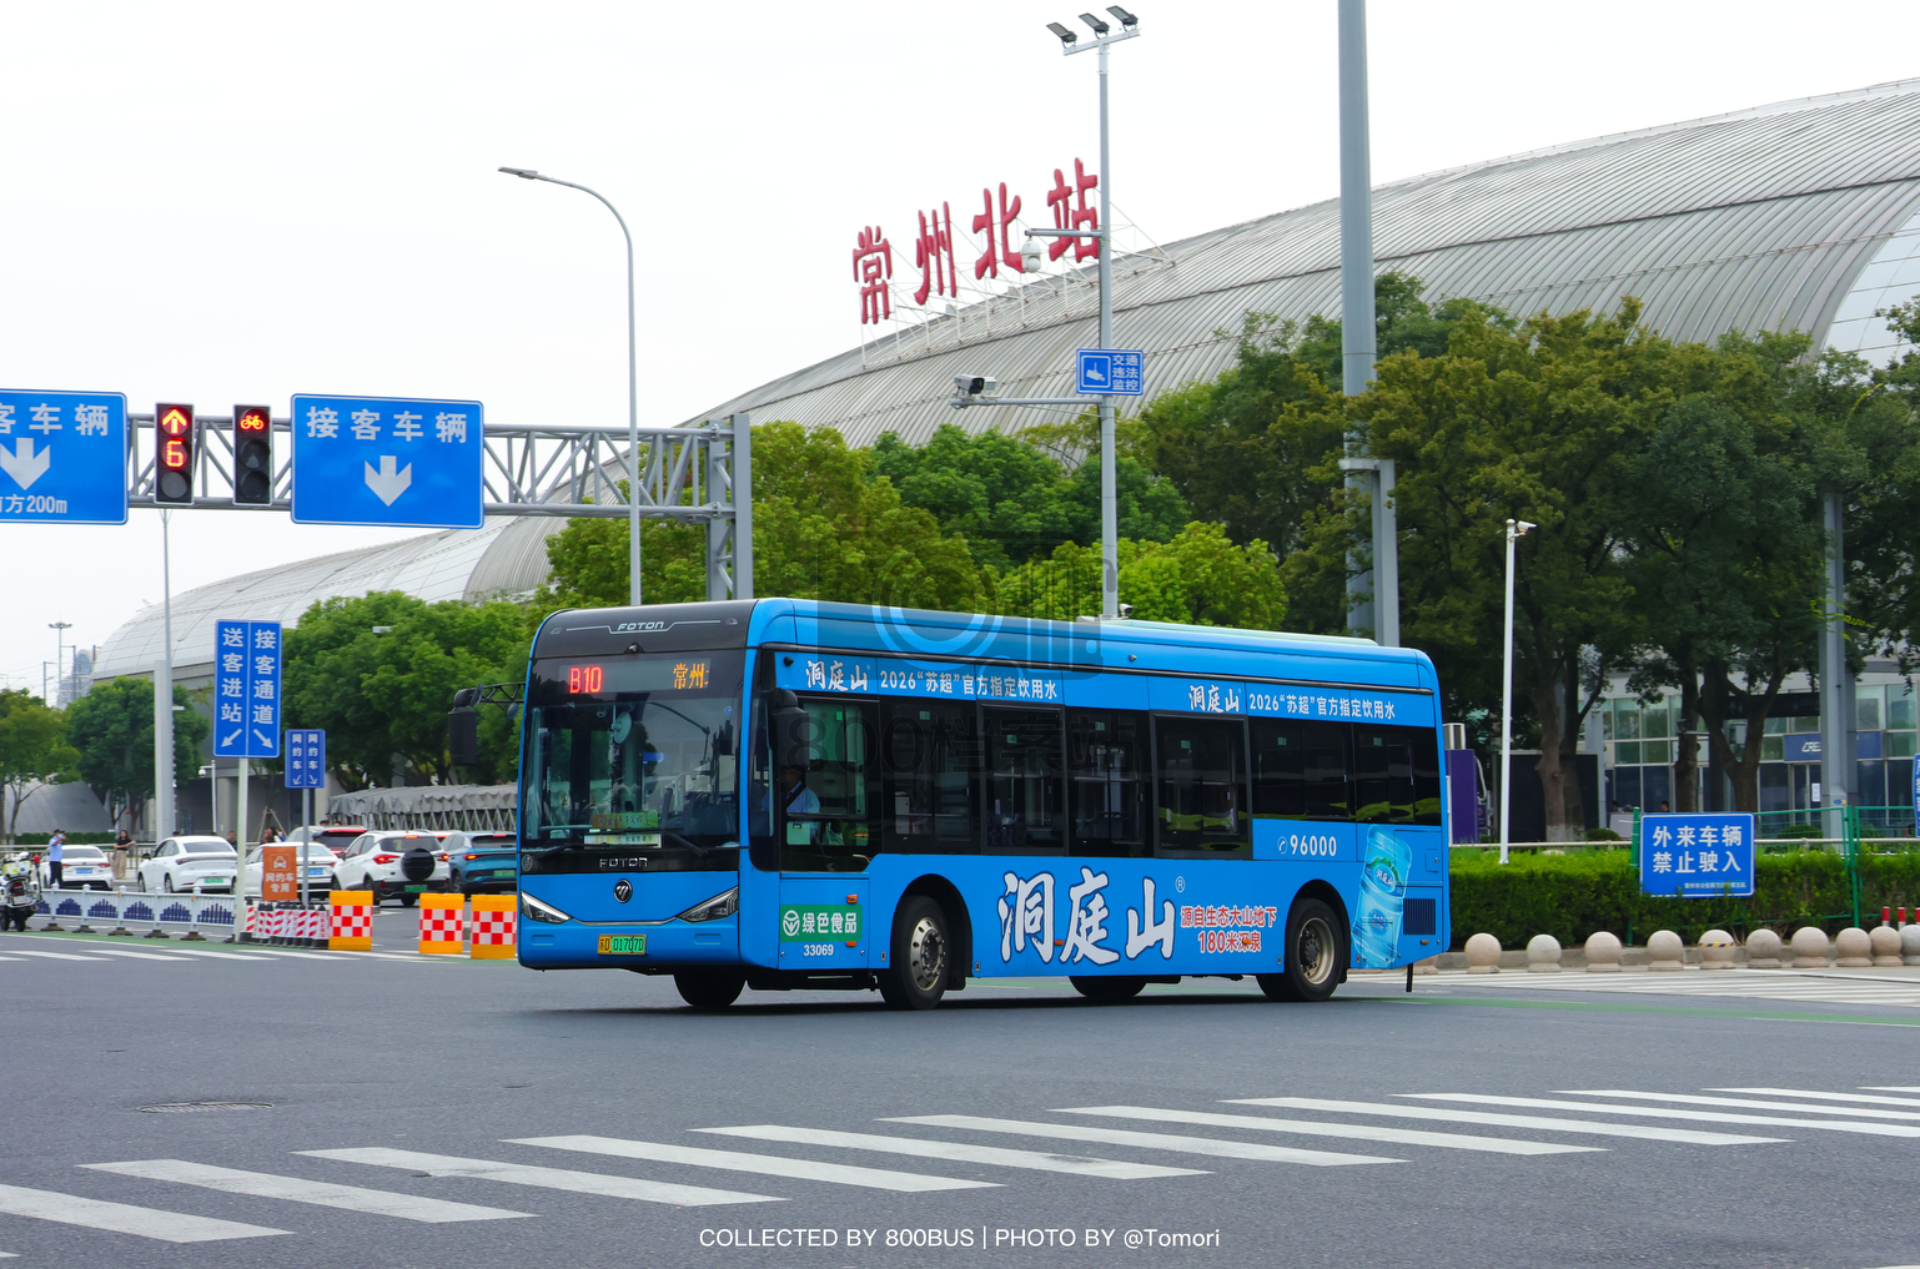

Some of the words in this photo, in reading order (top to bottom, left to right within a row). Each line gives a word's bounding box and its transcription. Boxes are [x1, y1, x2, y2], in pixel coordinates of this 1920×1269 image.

[853, 157, 1098, 324] 常州北站
[1112, 354, 1138, 366] 交通
[306, 406, 468, 444] 接客车辆
[166, 440, 184, 467] 6
[0, 494, 68, 514] 方200m
[617, 621, 665, 632] FOTON
[220, 627, 244, 723] 送客进站
[252, 629, 276, 725] 接客通道
[569, 665, 603, 694] B10
[673, 662, 709, 690] 常州
[806, 659, 868, 692] 洞庭山
[1188, 684, 1240, 713] 洞庭山
[1290, 834, 1337, 857] 96000
[1652, 825, 1742, 847] 外来车辆
[599, 857, 648, 868] FOTON
[1652, 851, 1742, 874] 禁止驶入
[802, 912, 858, 933] 绿色食品
[998, 865, 1176, 966] 洞庭山
[1180, 905, 1278, 928] 源自生态大山地下
[803, 944, 835, 956] 33069
[1198, 930, 1262, 953] 180米深泉
